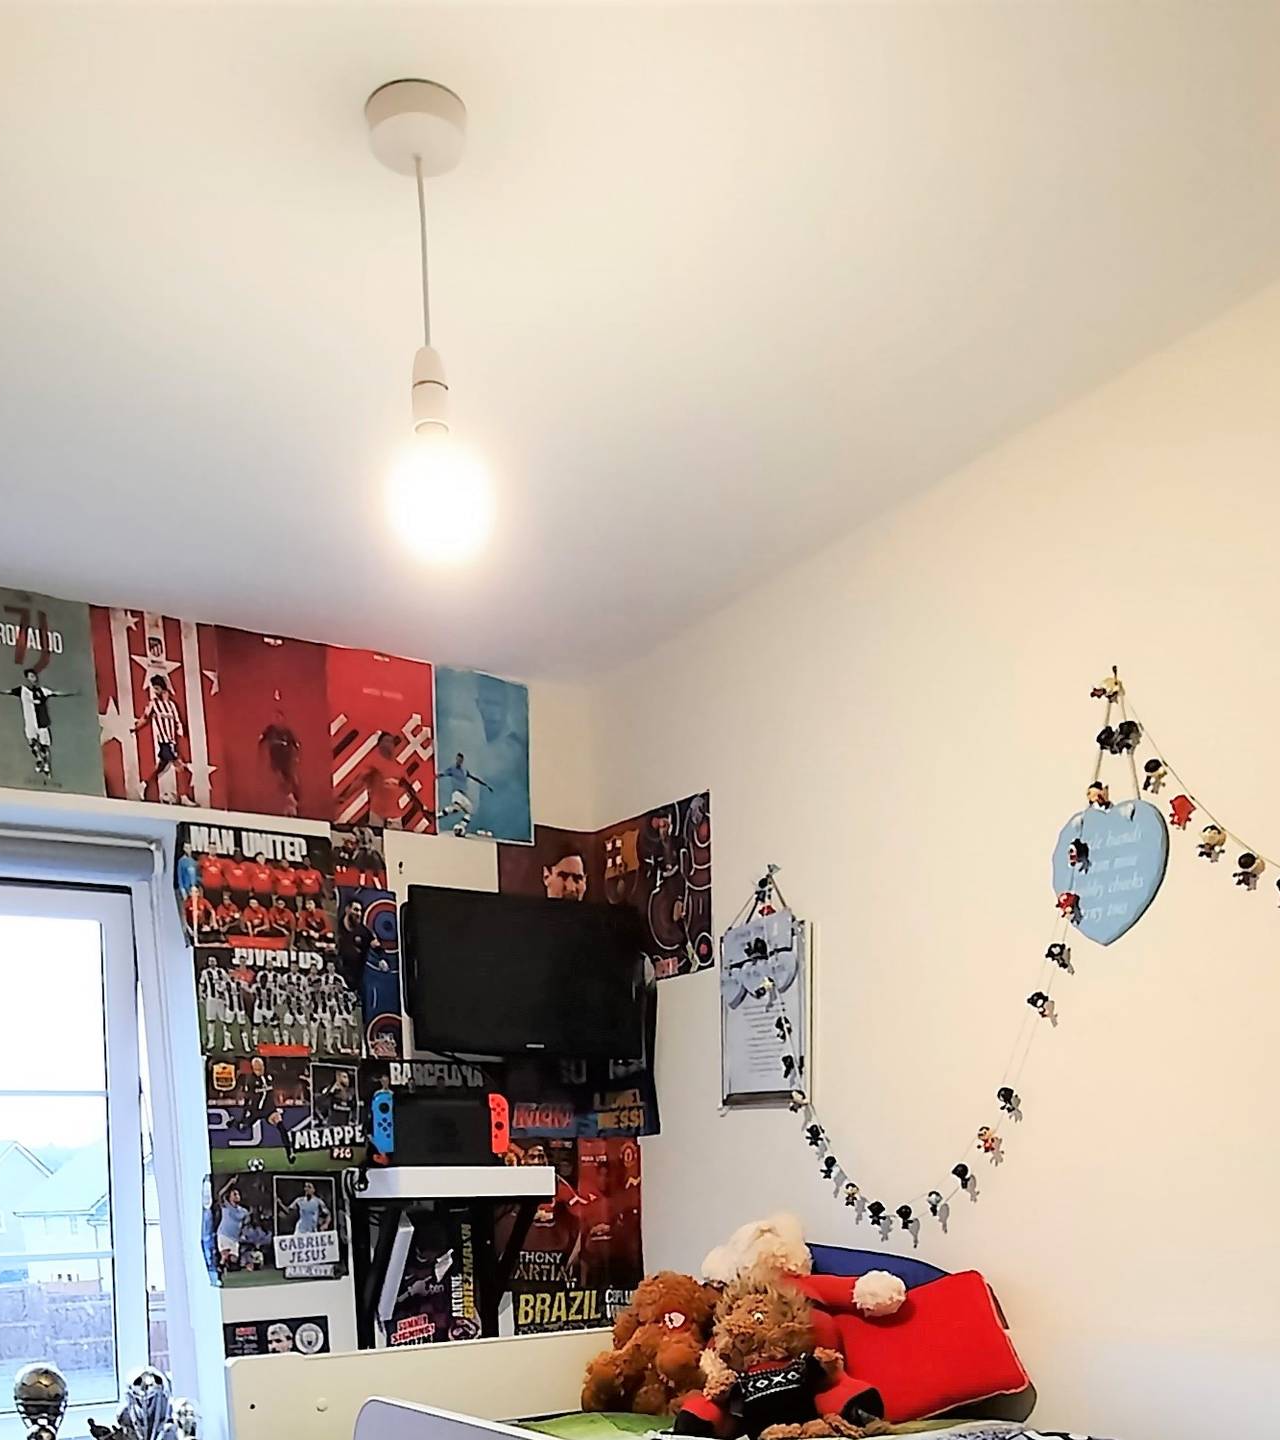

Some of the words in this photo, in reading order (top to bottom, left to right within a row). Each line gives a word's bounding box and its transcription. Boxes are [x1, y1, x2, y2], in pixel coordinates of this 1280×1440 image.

[189, 825, 235, 856] MAN
[241, 830, 308, 863] UNITED
[596, 1108, 645, 1131] ESSI
[293, 1123, 366, 1150] MBAPPE
[332, 1148, 352, 1160] PSG
[278, 1234, 336, 1251] GABRIEL
[288, 1248, 328, 1264] JESUS
[518, 1250, 563, 1264] THONY
[514, 1263, 577, 1283] ARTIAL
[517, 1289, 602, 1326] BRAZIL
